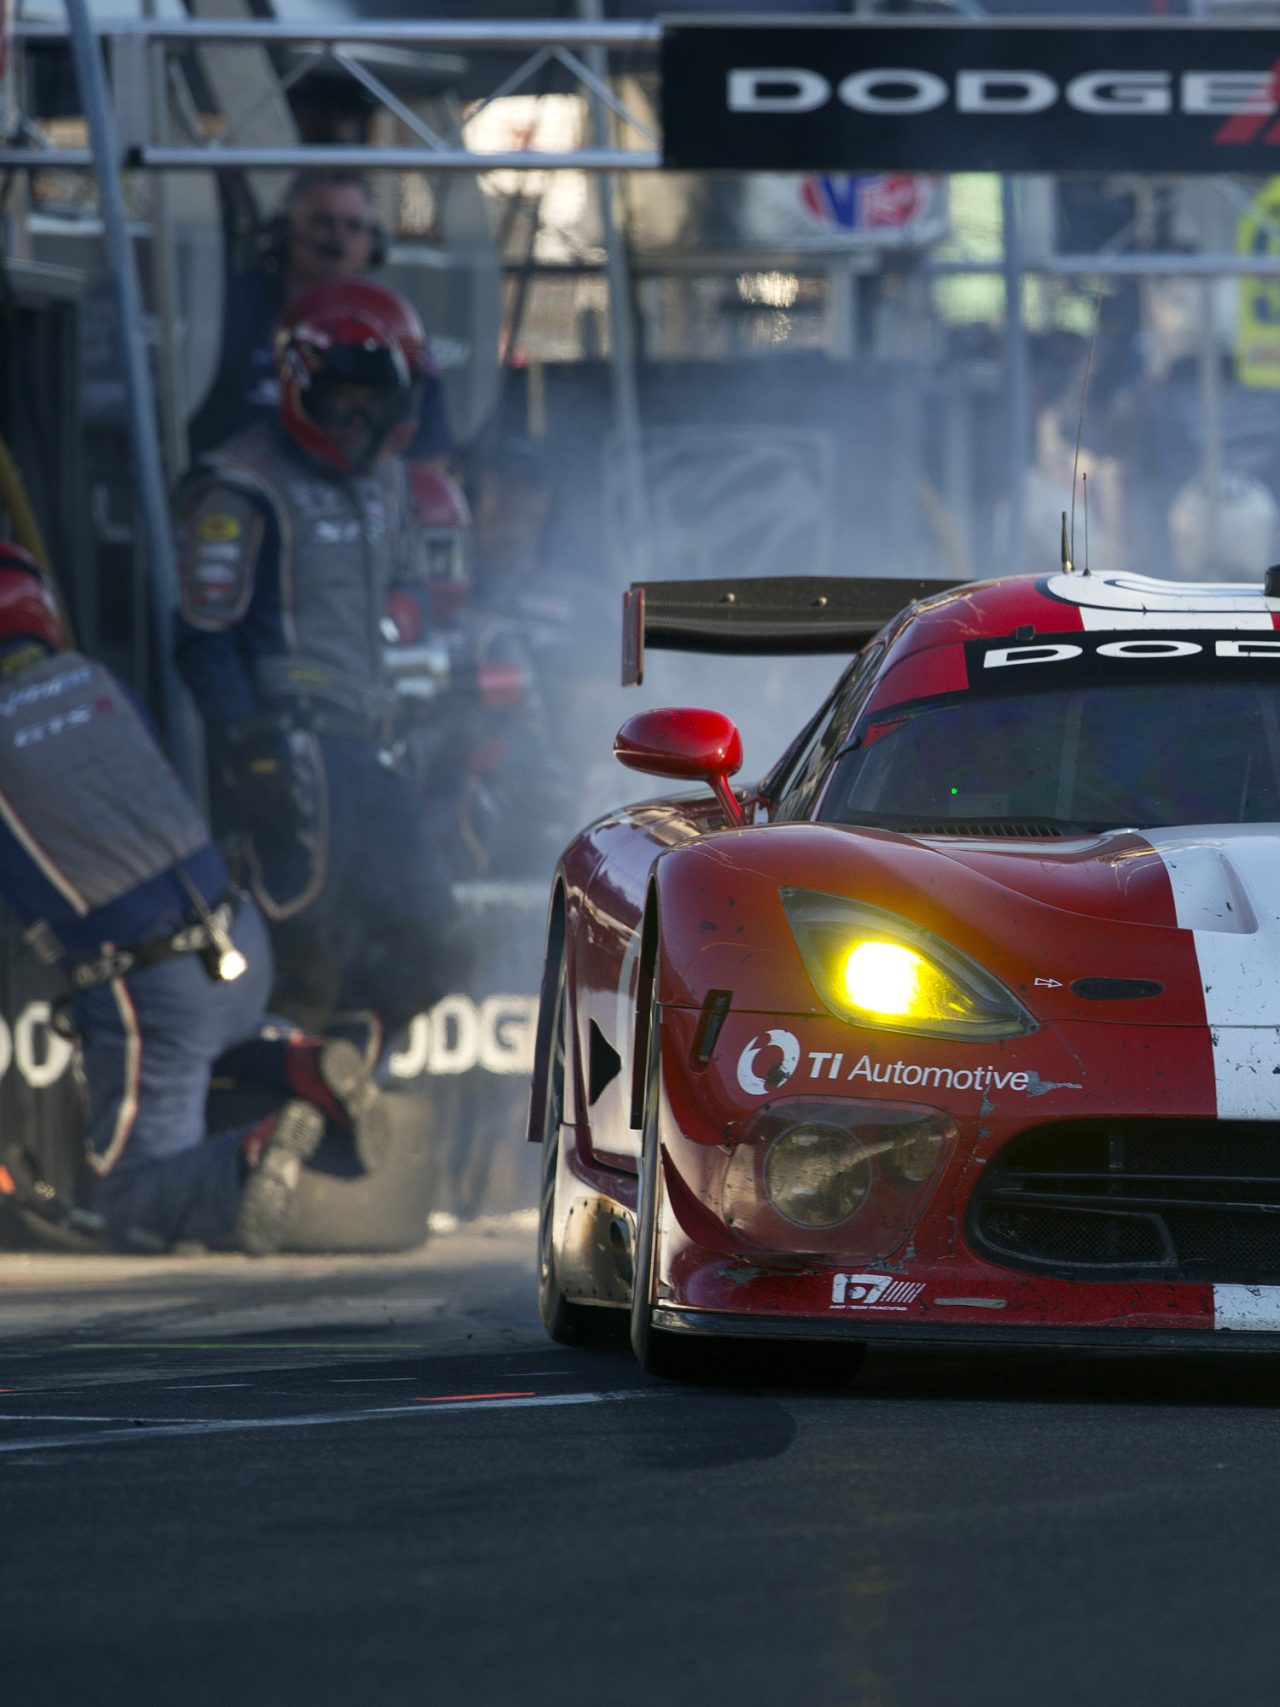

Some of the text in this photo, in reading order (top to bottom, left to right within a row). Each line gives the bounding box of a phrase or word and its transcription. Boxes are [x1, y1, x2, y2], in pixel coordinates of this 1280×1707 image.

[726, 67, 1278, 115] DODGE
[807, 1051, 1030, 1092] TI Automotive
